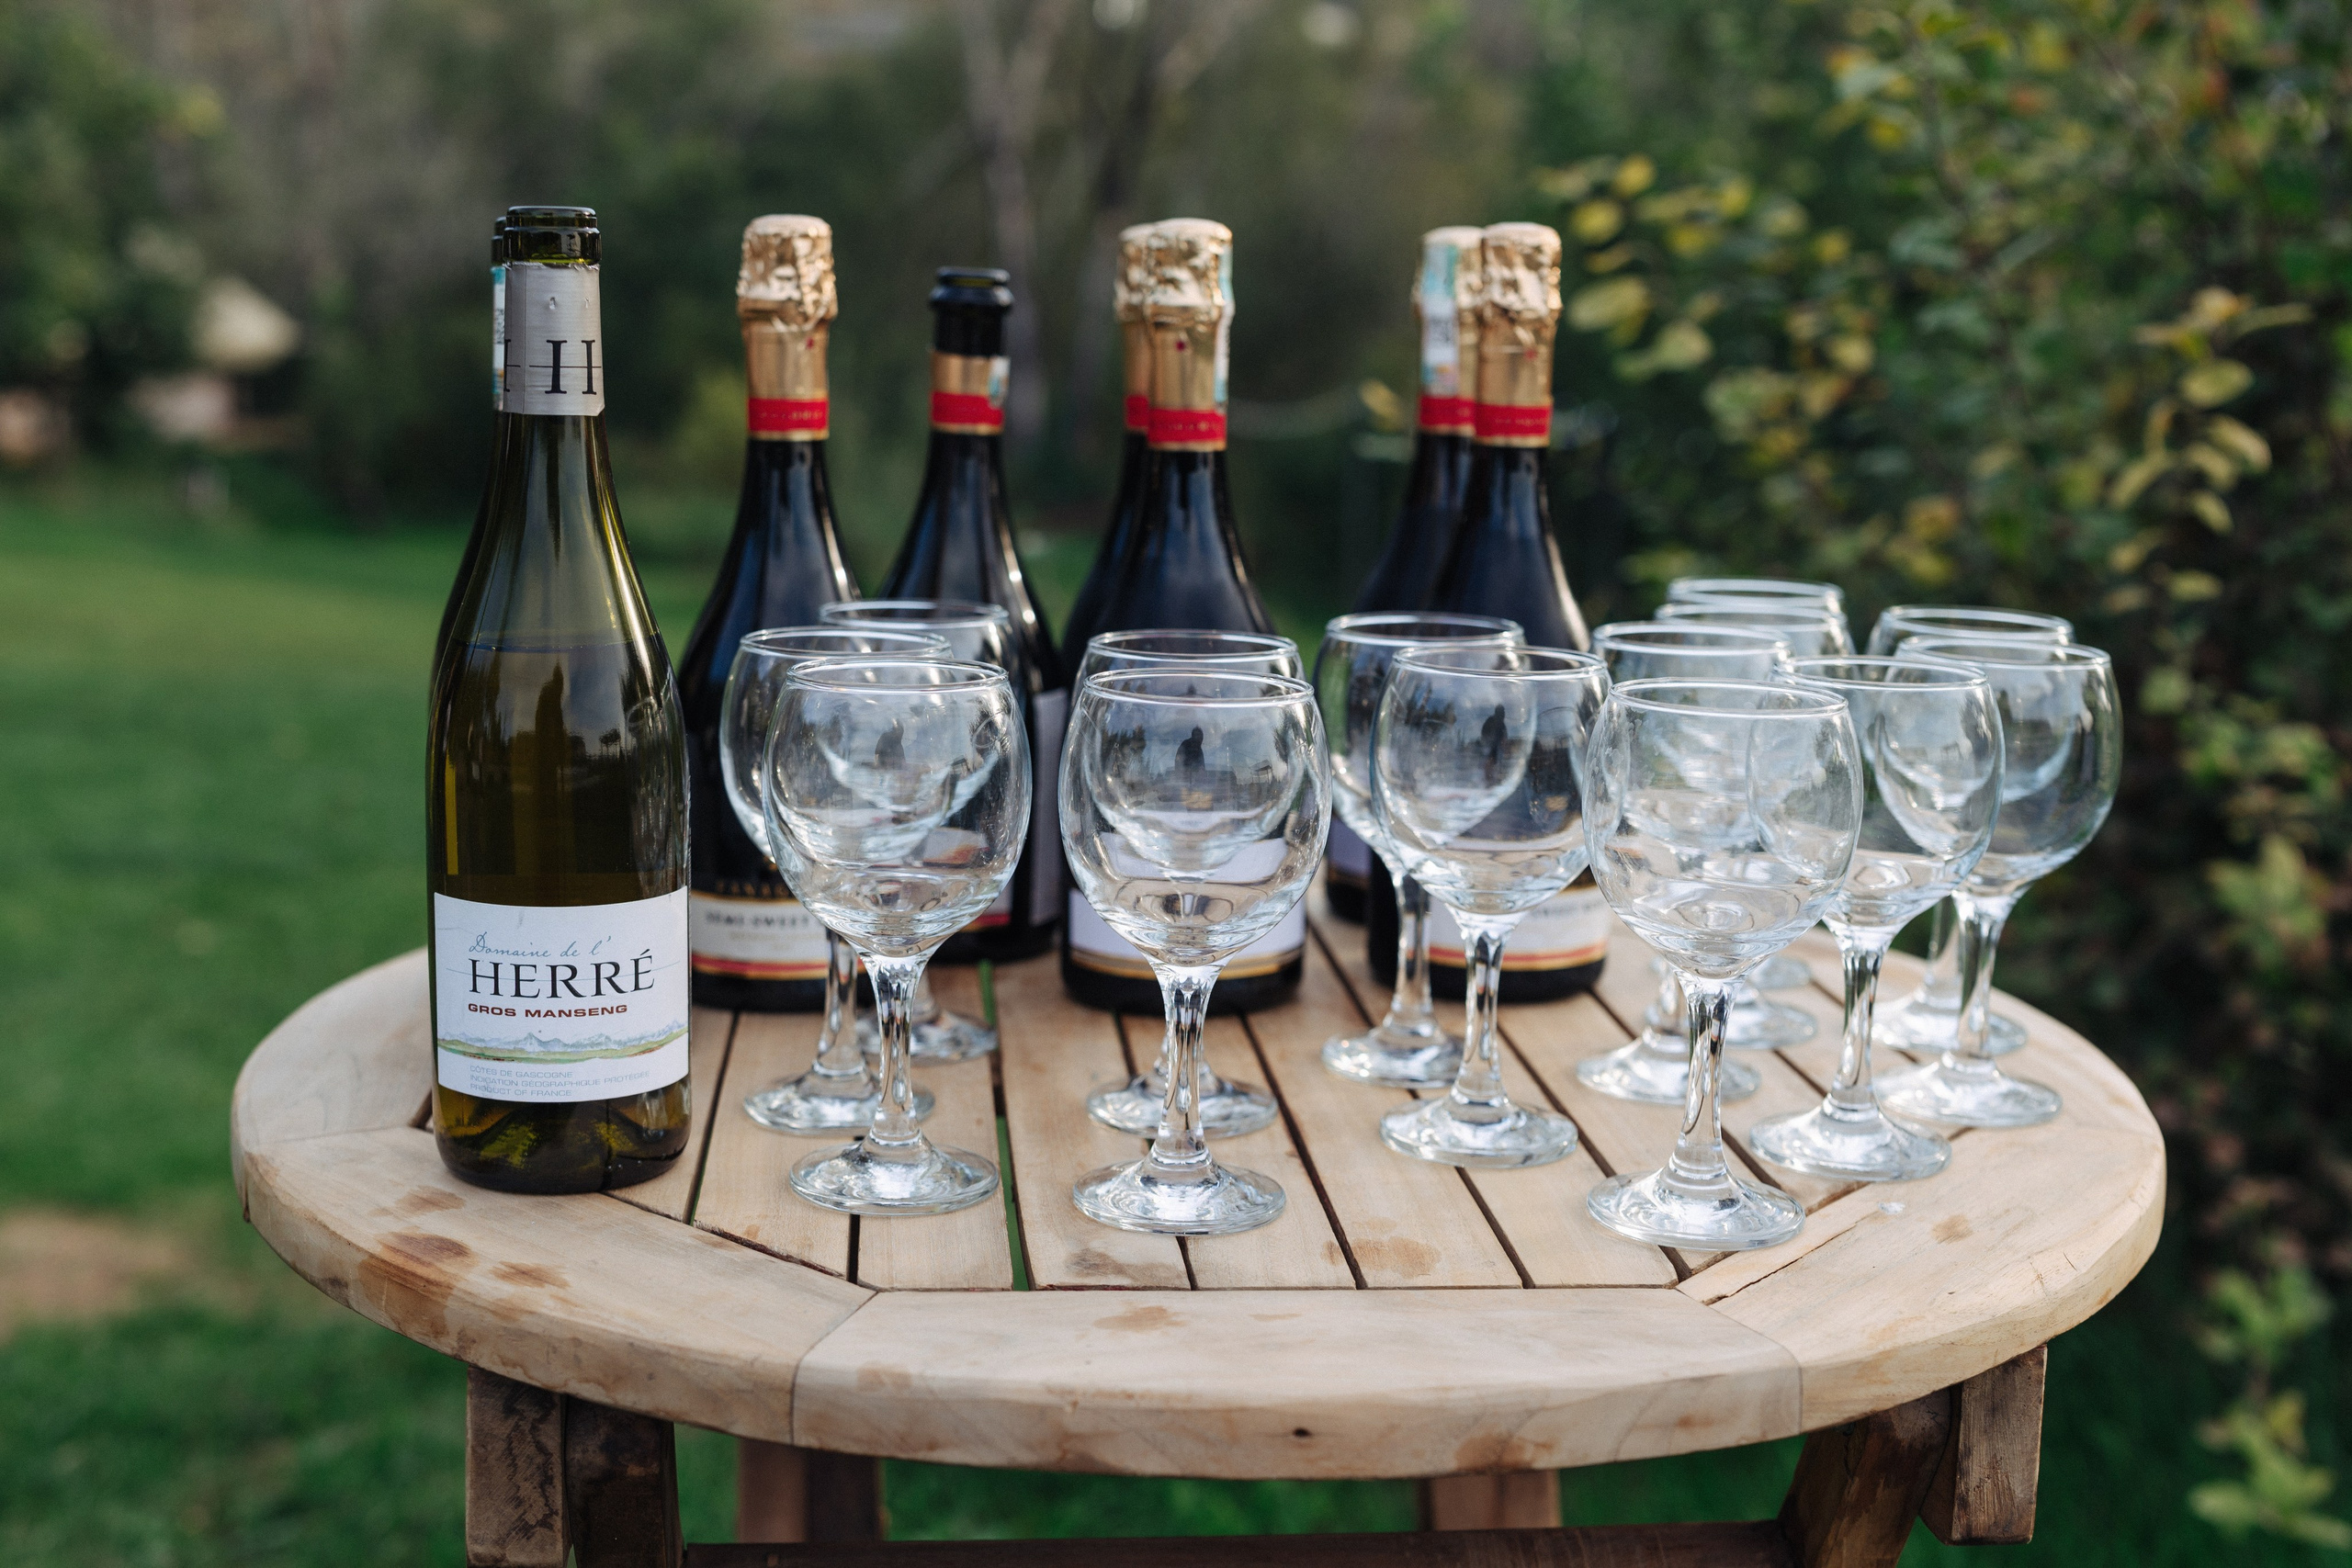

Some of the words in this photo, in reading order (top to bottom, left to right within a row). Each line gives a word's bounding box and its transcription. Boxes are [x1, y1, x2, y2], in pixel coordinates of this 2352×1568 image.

[469, 931, 551, 957] Domaine
[560, 941, 581, 957] de
[468, 949, 655, 998] HERRÉ
[468, 1003, 516, 1017] GROS
[525, 1004, 628, 1019] MANSENG
[469, 1066, 497, 1076] CÔTES
[469, 1075, 518, 1087] INDICATION
[521, 1078, 601, 1088] GÉOGRAPHIQUE
[604, 1070, 650, 1084] PROTÉGÉE
[469, 1083, 511, 1095] PRODUCT
